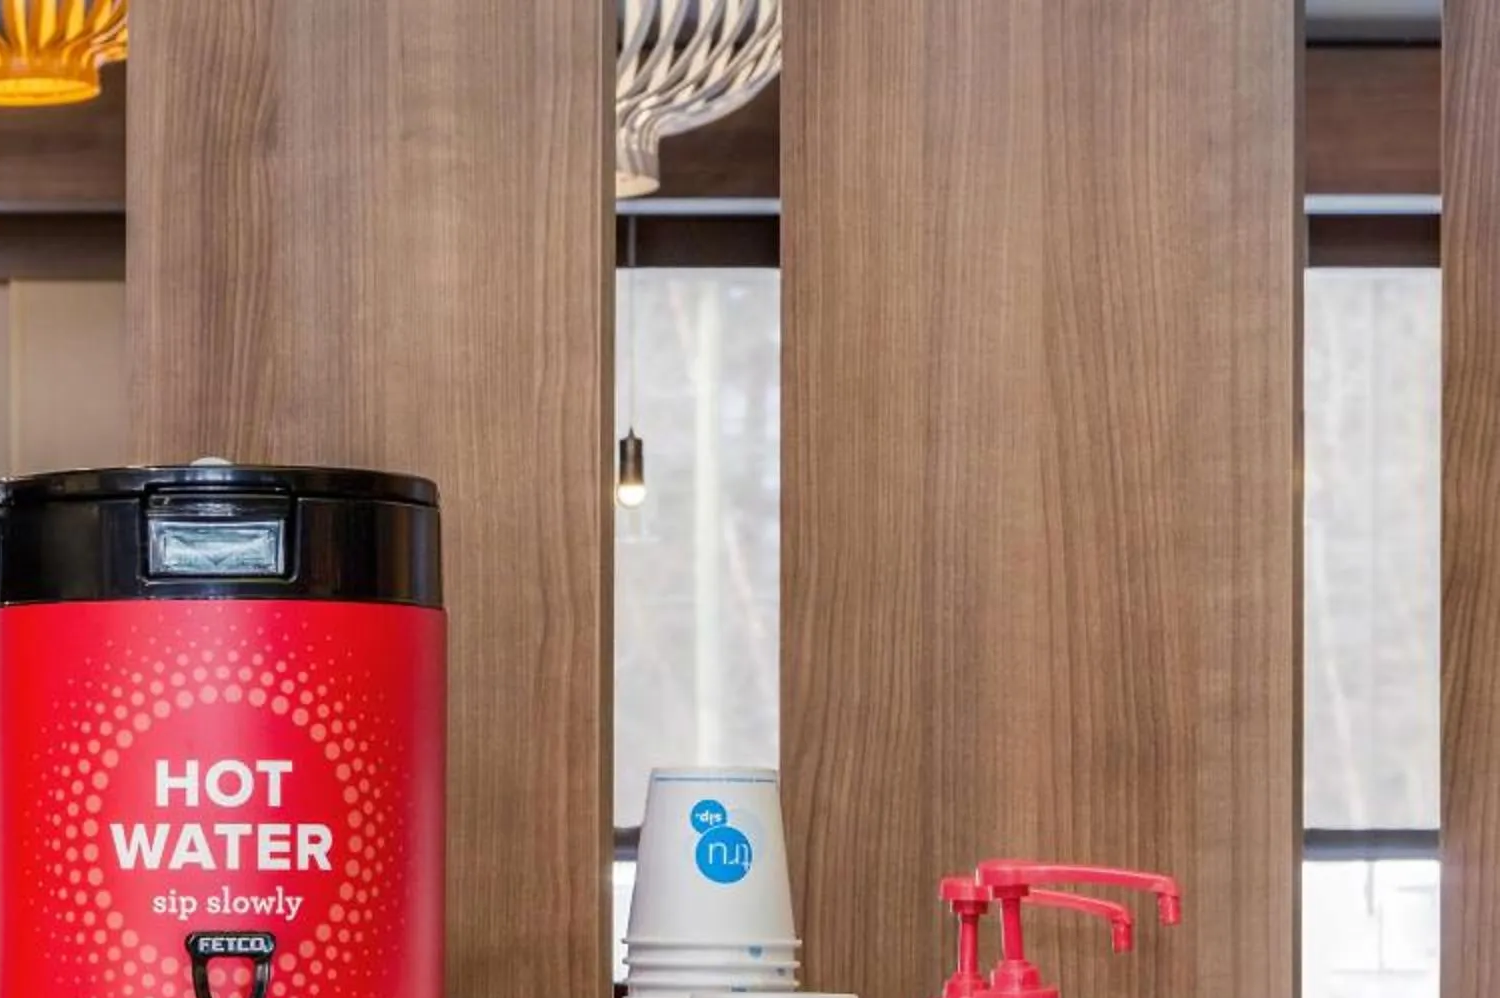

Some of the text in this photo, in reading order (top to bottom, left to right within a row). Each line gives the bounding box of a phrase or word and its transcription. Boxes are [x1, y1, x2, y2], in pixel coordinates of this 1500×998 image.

[155, 759, 293, 807] HOT
[110, 823, 332, 870] WATER
[709, 842, 749, 870] tru
[153, 886, 303, 920] sip slowly
[198, 937, 265, 952] FETCO
